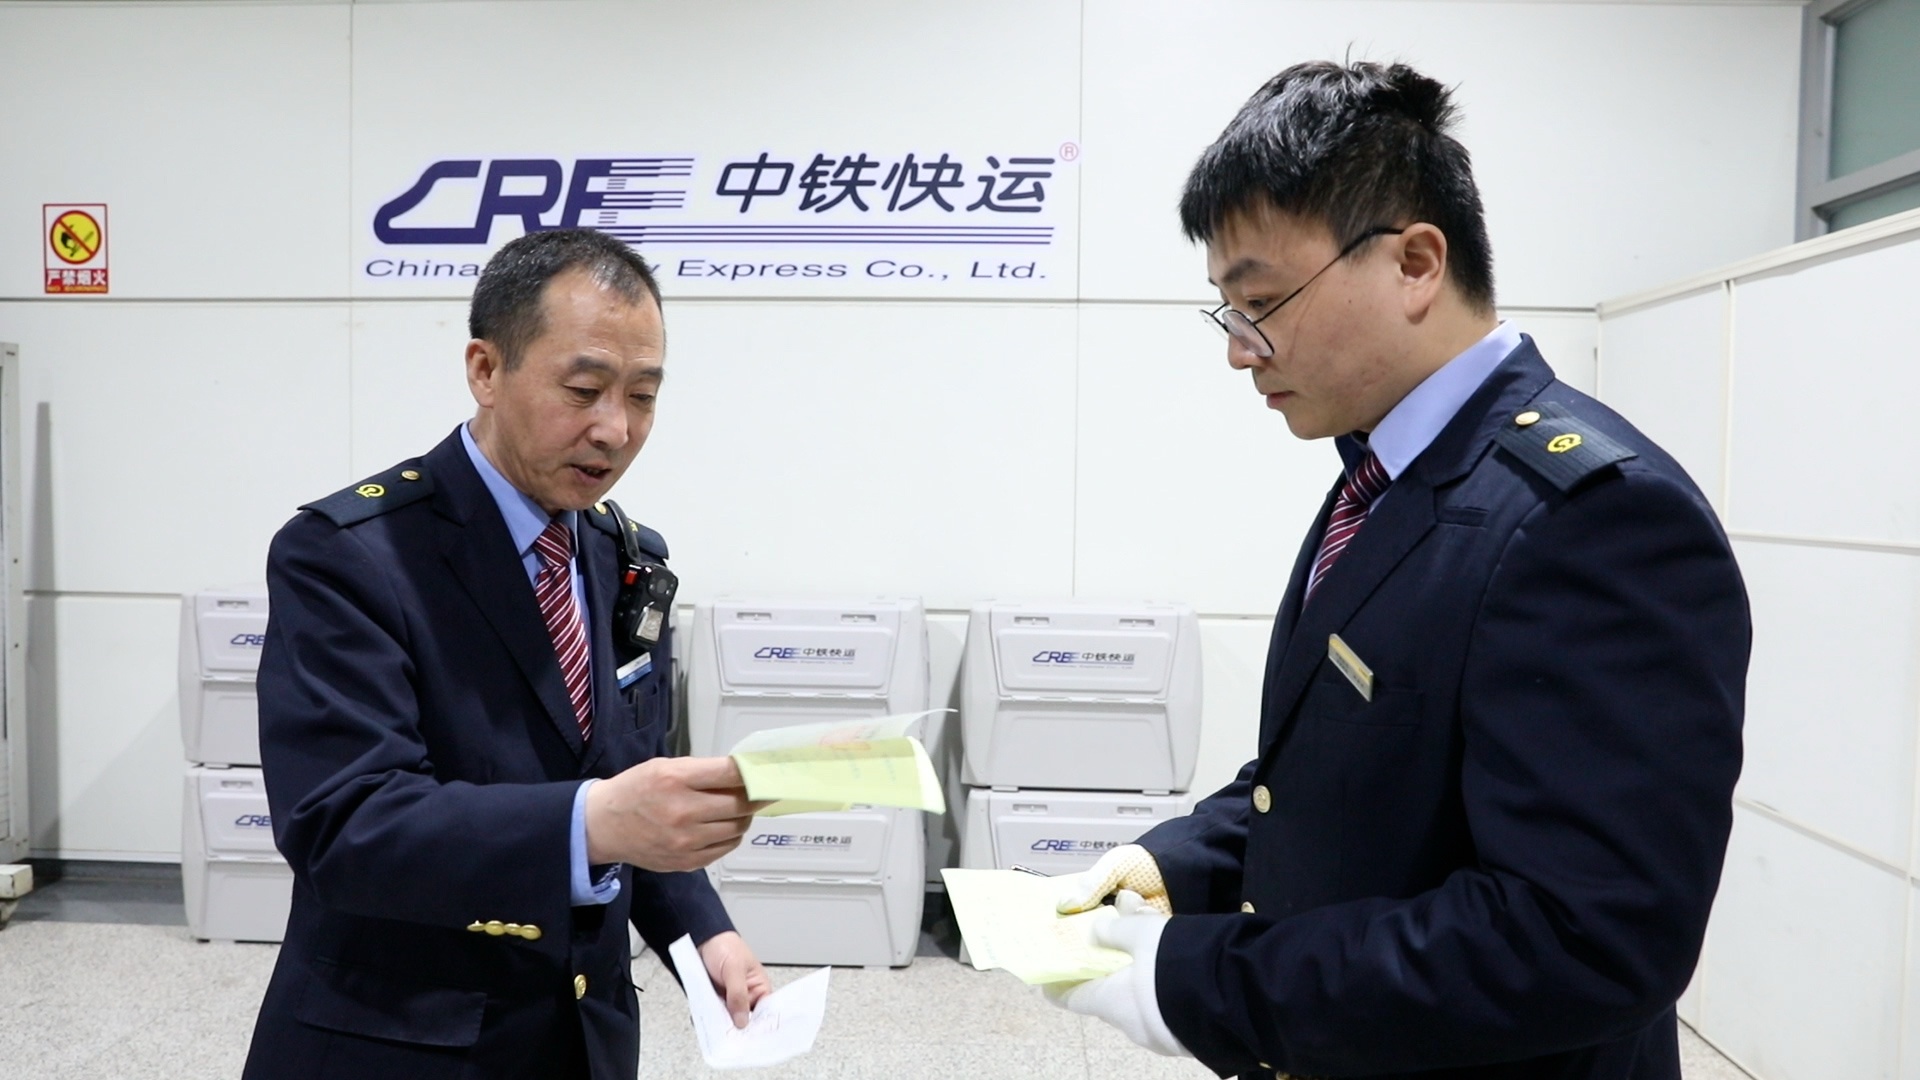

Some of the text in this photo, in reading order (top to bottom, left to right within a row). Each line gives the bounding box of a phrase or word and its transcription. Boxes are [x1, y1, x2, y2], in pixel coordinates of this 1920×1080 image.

[715, 152, 1055, 214] 中铁快运
[366, 259, 480, 277] China
[677, 259, 848, 281] Express
[866, 260, 948, 281] Co.,
[970, 261, 1046, 279] Ltd.
[802, 647, 856, 658] 中铁快运
[1081, 652, 1135, 662] 中铁快运
[800, 835, 853, 845] 中铁快运
[1080, 840, 1132, 849] 中铁快
